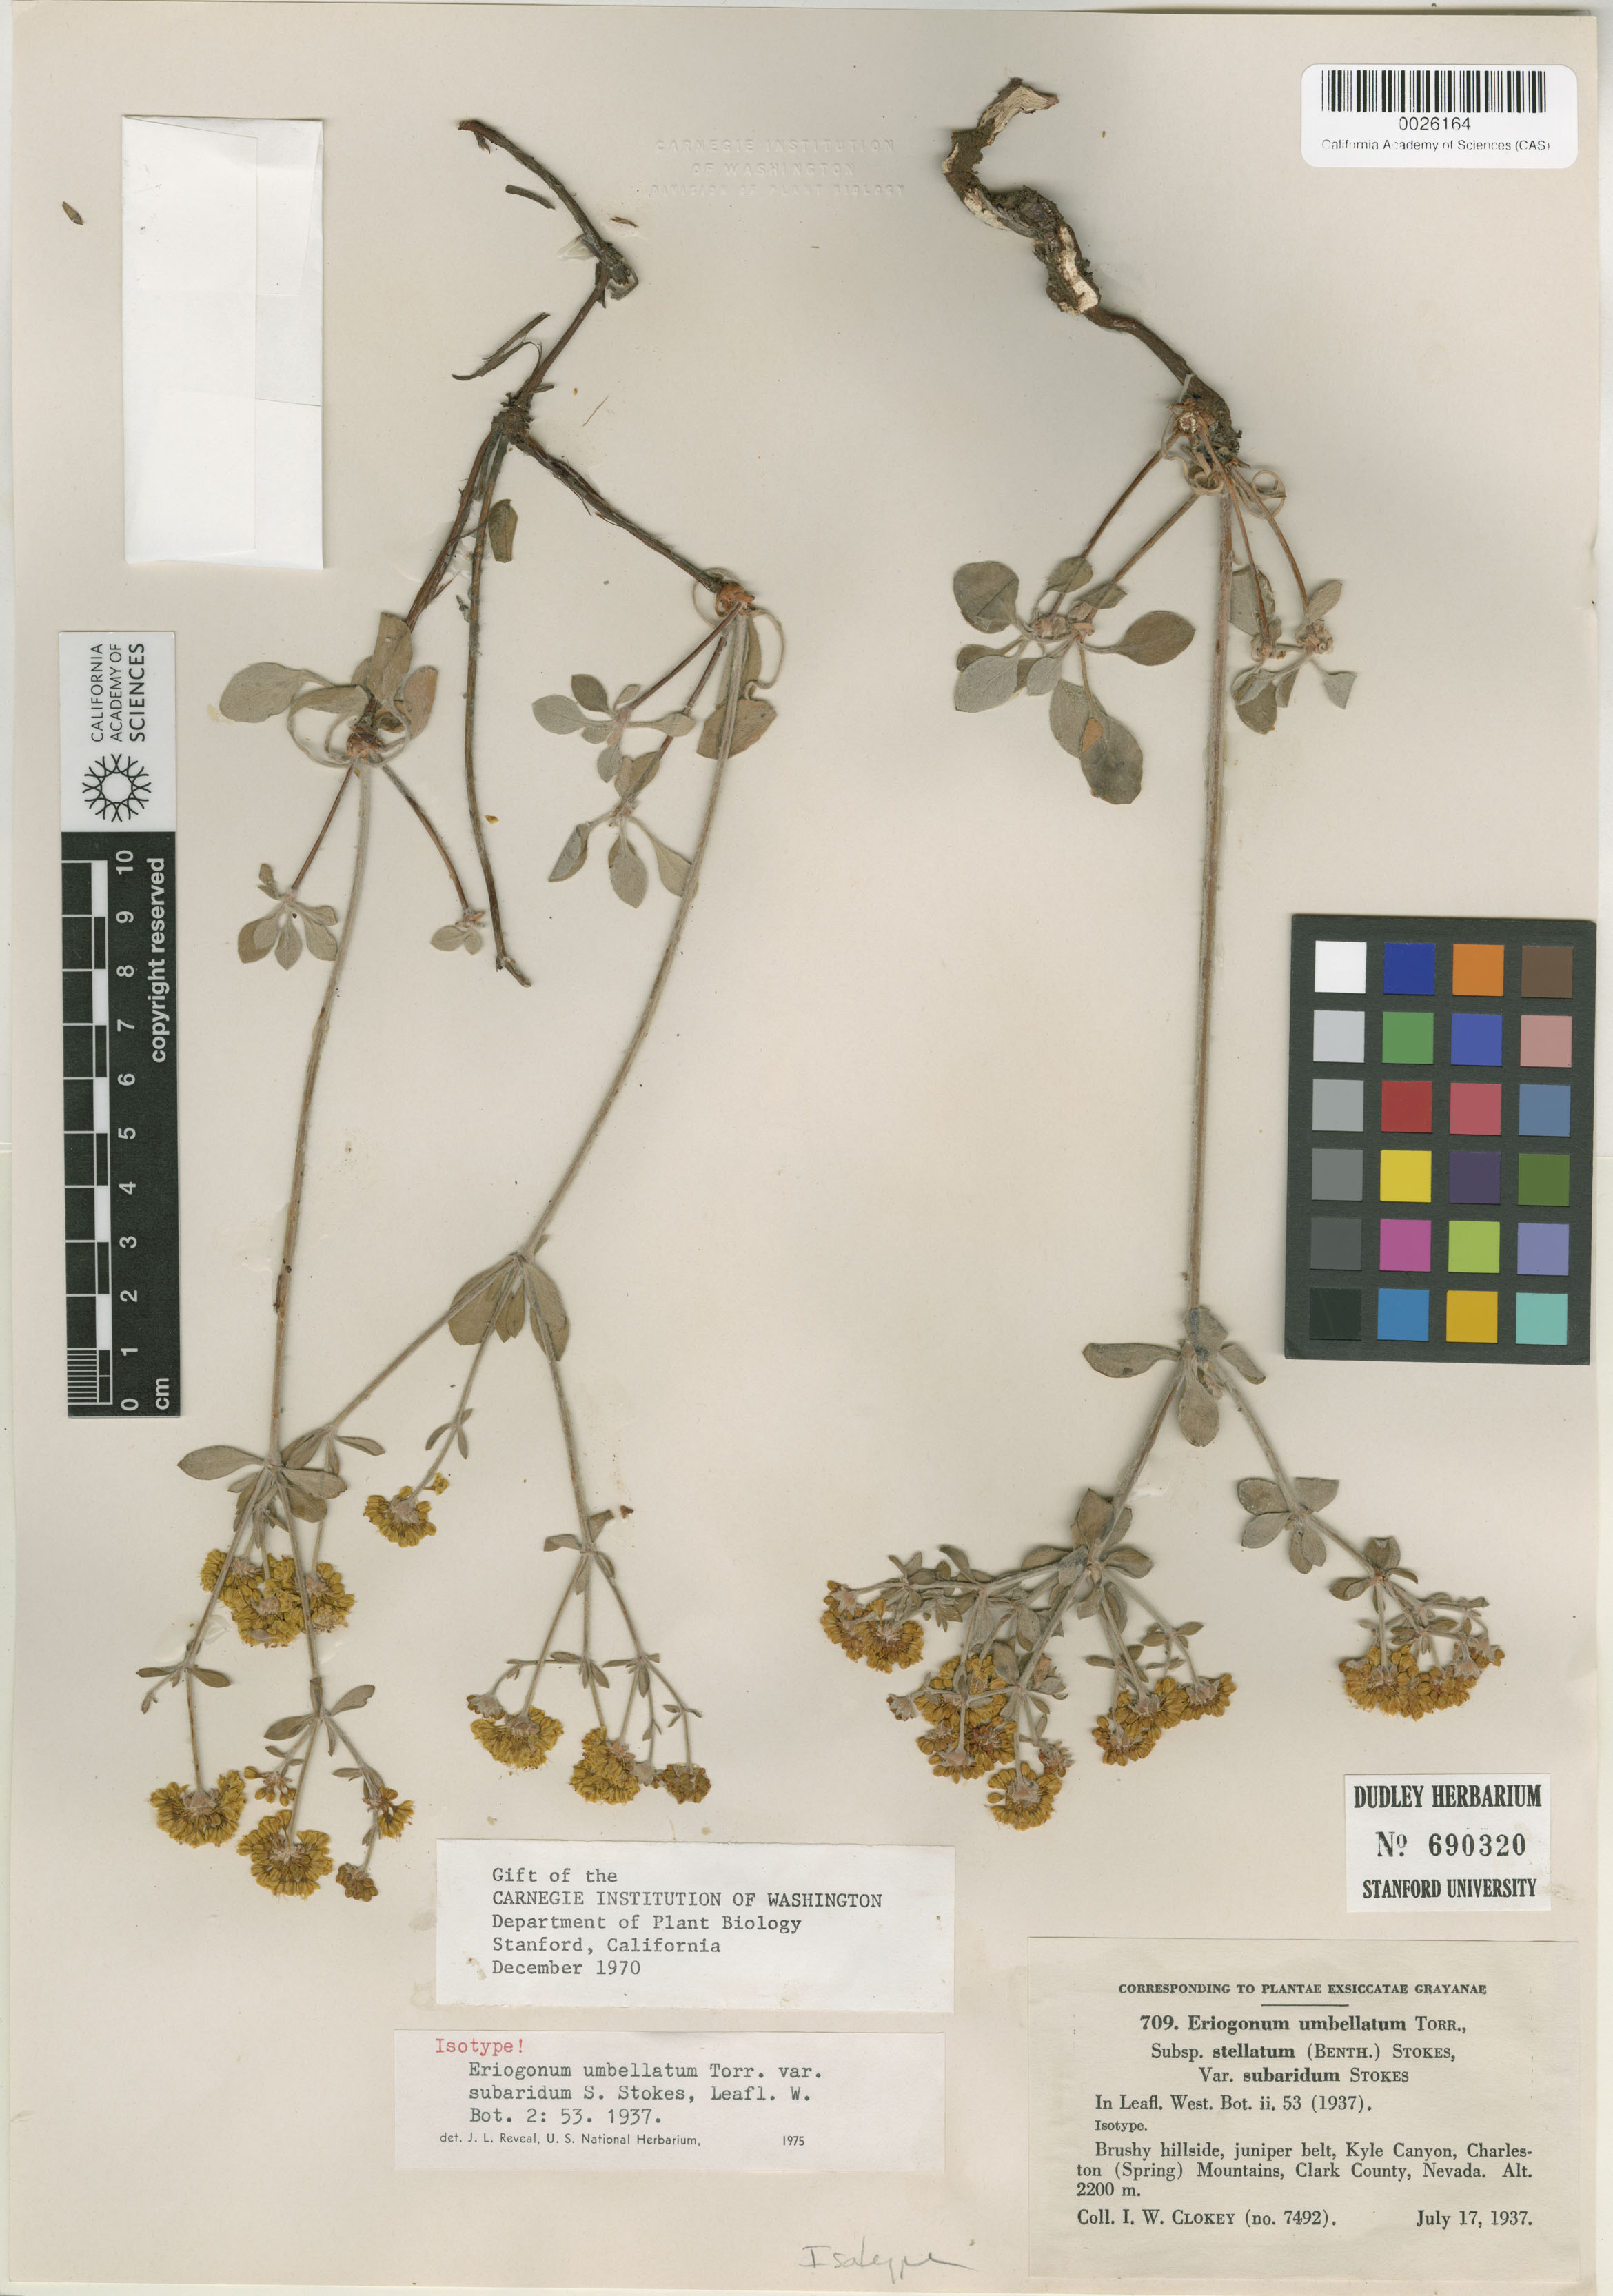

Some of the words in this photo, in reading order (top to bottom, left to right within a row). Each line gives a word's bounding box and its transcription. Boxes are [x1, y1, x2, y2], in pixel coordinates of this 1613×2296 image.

[1398, 116, 1471, 131] 0026164
[656, 139, 755, 153] CARNEGIE
[767, 139, 894, 152] INSTITUTION
[1321, 139, 1379, 150] California
[1383, 139, 1439, 152] Academy
[1442, 139, 1454, 150] of
[1457, 139, 1512, 150] Sciences
[1515, 139, 1550, 152] (CAS)
[693, 163, 714, 177] OF
[724, 163, 855, 177] WASHINGTON
[109, 643, 122, 663] OF
[90, 643, 104, 742] CALIFORNIA
[128, 643, 145, 742] SCIENCES
[110, 666, 123, 742] ACADEMY
[115, 849, 134, 875] 10
[145, 857, 165, 953] reserved
[115, 911, 134, 924] 9
[116, 964, 134, 978] 8
[147, 958, 170, 1063] copyright
[116, 1019, 135, 1032] 7
[116, 1073, 136, 1086] 6
[117, 1127, 136, 1140] 5
[118, 1181, 136, 1195] 4
[119, 1235, 137, 1249] 3
[119, 1290, 138, 1303] 2
[120, 1348, 139, 1357] 1
[155, 1377, 170, 1410] cm
[120, 1398, 139, 1411] 0
[1353, 1785, 1425, 1809] DUDLEY
[1431, 1784, 1543, 1808] HERBARIUM
[1428, 1833, 1526, 1857] 690320
[492, 1867, 538, 1882] Gift
[549, 1867, 571, 1883] of
[585, 1868, 618, 1883] the
[1363, 1879, 1442, 1899] STANFORD
[1446, 1878, 1538, 1898] UNIVERSITY
[492, 1890, 584, 1906] CARNEGIE
[596, 1891, 722, 1907] INSTITUTION
[732, 1892, 756, 1907] OF
[767, 1892, 882, 1908] WASHINGTON
[491, 1913, 607, 1932] Department
[618, 1913, 640, 1929] of
[652, 1914, 709, 1930] Plant
[722, 1915, 802, 1935] Biology
[493, 1936, 594, 1955] Stanford,
[607, 1937, 721, 1953] California
[491, 1959, 583, 1975] December
[596, 1960, 641, 1975] 1970
[1118, 1983, 1231, 1994] CORRESPONDING
[1236, 1984, 1255, 1994] TO
[1261, 1984, 1322, 1995] PLANTAE
[1327, 1984, 1408, 1995] EXSICCATAE
[1414, 1984, 1487, 1995] GRAYANAE
[1139, 2014, 1179, 2031] 709.
[1187, 2014, 1290, 2035] Eriogonum
[1298, 2015, 1407, 2031] umbellatum
[435, 2038, 523, 2057] Isotype!
[1151, 2042, 1204, 2063] Subsp.
[1213, 2042, 1296, 2059] stellatum
[468, 2062, 572, 2080] Eriogonum
[582, 2062, 698, 2078] umbellatum
[709, 2062, 764, 2079] Torr.
[778, 2066, 822, 2079] var.
[1198, 2066, 1234, 2083] Var.
[1243, 2066, 1341, 2083] subaridum
[469, 2084, 572, 2100] subaridum
[583, 2085, 605, 2100] S.
[618, 2085, 694, 2104] Stokes,
[711, 2086, 775, 2101] Leafl.
[790, 2086, 810, 2102] W.
[1095, 2094, 1113, 2110] In
[1119, 2094, 1163, 2111] Leafl.
[1169, 2094, 1213, 2111] West.
[1220, 2094, 1252, 2111] Bot.
[1259, 2095, 1276, 2111] ii.
[1282, 2095, 1302, 2111] 53
[1311, 2094, 1372, 2113] (1937).
[469, 2107, 512, 2123] Bot.
[527, 2108, 546, 2123] 2:
[561, 2108, 592, 2126] 53.
[608, 2108, 661, 2126] 1937.
[1094, 2120, 1148, 2133] Isotype.
[439, 2131, 463, 2143] det.
[467, 2132, 478, 2143] J.
[483, 2132, 494, 2143] L.
[500, 2132, 540, 2146] Reveal,
[547, 2133, 559, 2144] U.
[564, 2133, 575, 2144] S.
[581, 2133, 630, 2145] National
[636, 2133, 700, 2147] Herbarium,
[782, 2135, 805, 2146] 1975
[1095, 2141, 1152, 2162] Brushy
[1159, 2141, 1225, 2160] hillside,
[1233, 2142, 1293, 2162] juniper
[1301, 2142, 1337, 2160] belt,
[1345, 2142, 1383, 2162] Kyle
[1392, 2142, 1457, 2162] Canyon,
[1466, 2142, 1532, 2158] Charles-
[1076, 2164, 1102, 2177] ton
[1115, 2161, 1183, 2182] (Spring)
[1196, 2162, 1284, 2180] Mountains,
[1295, 2162, 1341, 2178] Clark
[1350, 2162, 1412, 2182] County,
[1422, 2162, 1486, 2179] Nevada.
[1501, 2162, 1532, 2179] Alt.
[1076, 2181, 1115, 2197] 2200
[1121, 2186, 1141, 2197] m.
[1077, 2208, 1115, 2226] Coll.
[1122, 2208, 1135, 2226] I.
[1141, 2208, 1164, 2225] W.
[1245, 2208, 1276, 2228] (no.
[1284, 2208, 1337, 2228] 7492).
[1416, 2209, 1452, 2231] July
[1459, 2210, 1483, 2228] 17,
[1490, 2210, 1533, 2226] 1937.
